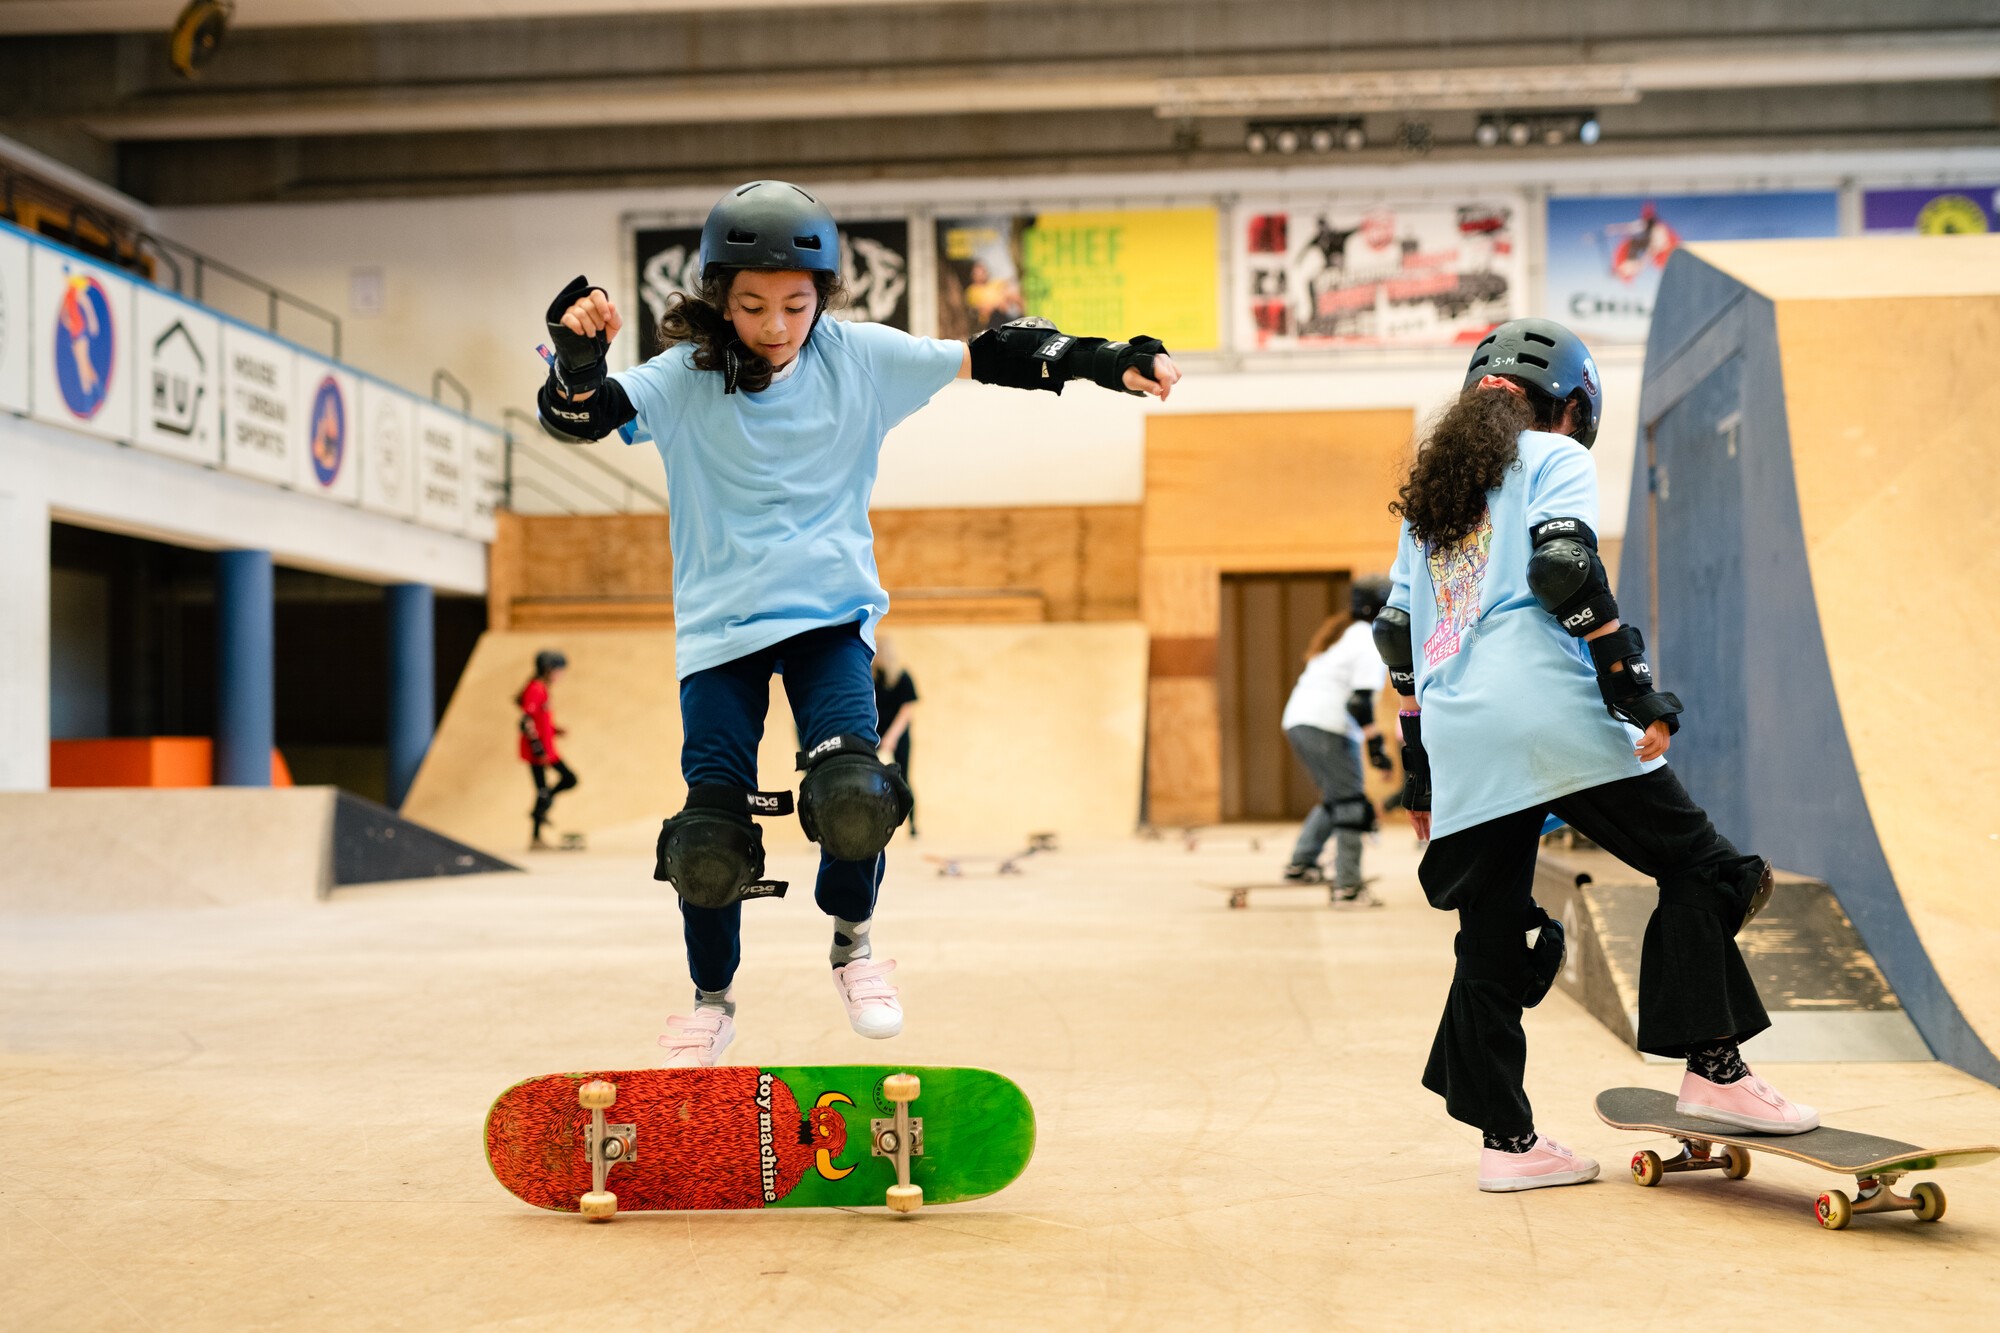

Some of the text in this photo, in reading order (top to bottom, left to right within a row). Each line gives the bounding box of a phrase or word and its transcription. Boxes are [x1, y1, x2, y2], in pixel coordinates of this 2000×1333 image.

[1024, 226, 1124, 268] CHEF
[1548, 520, 1575, 530] TSG
[1569, 607, 1593, 627] TSG
[1425, 619, 1451, 657] GIRLS
[755, 796, 779, 807] TSG
